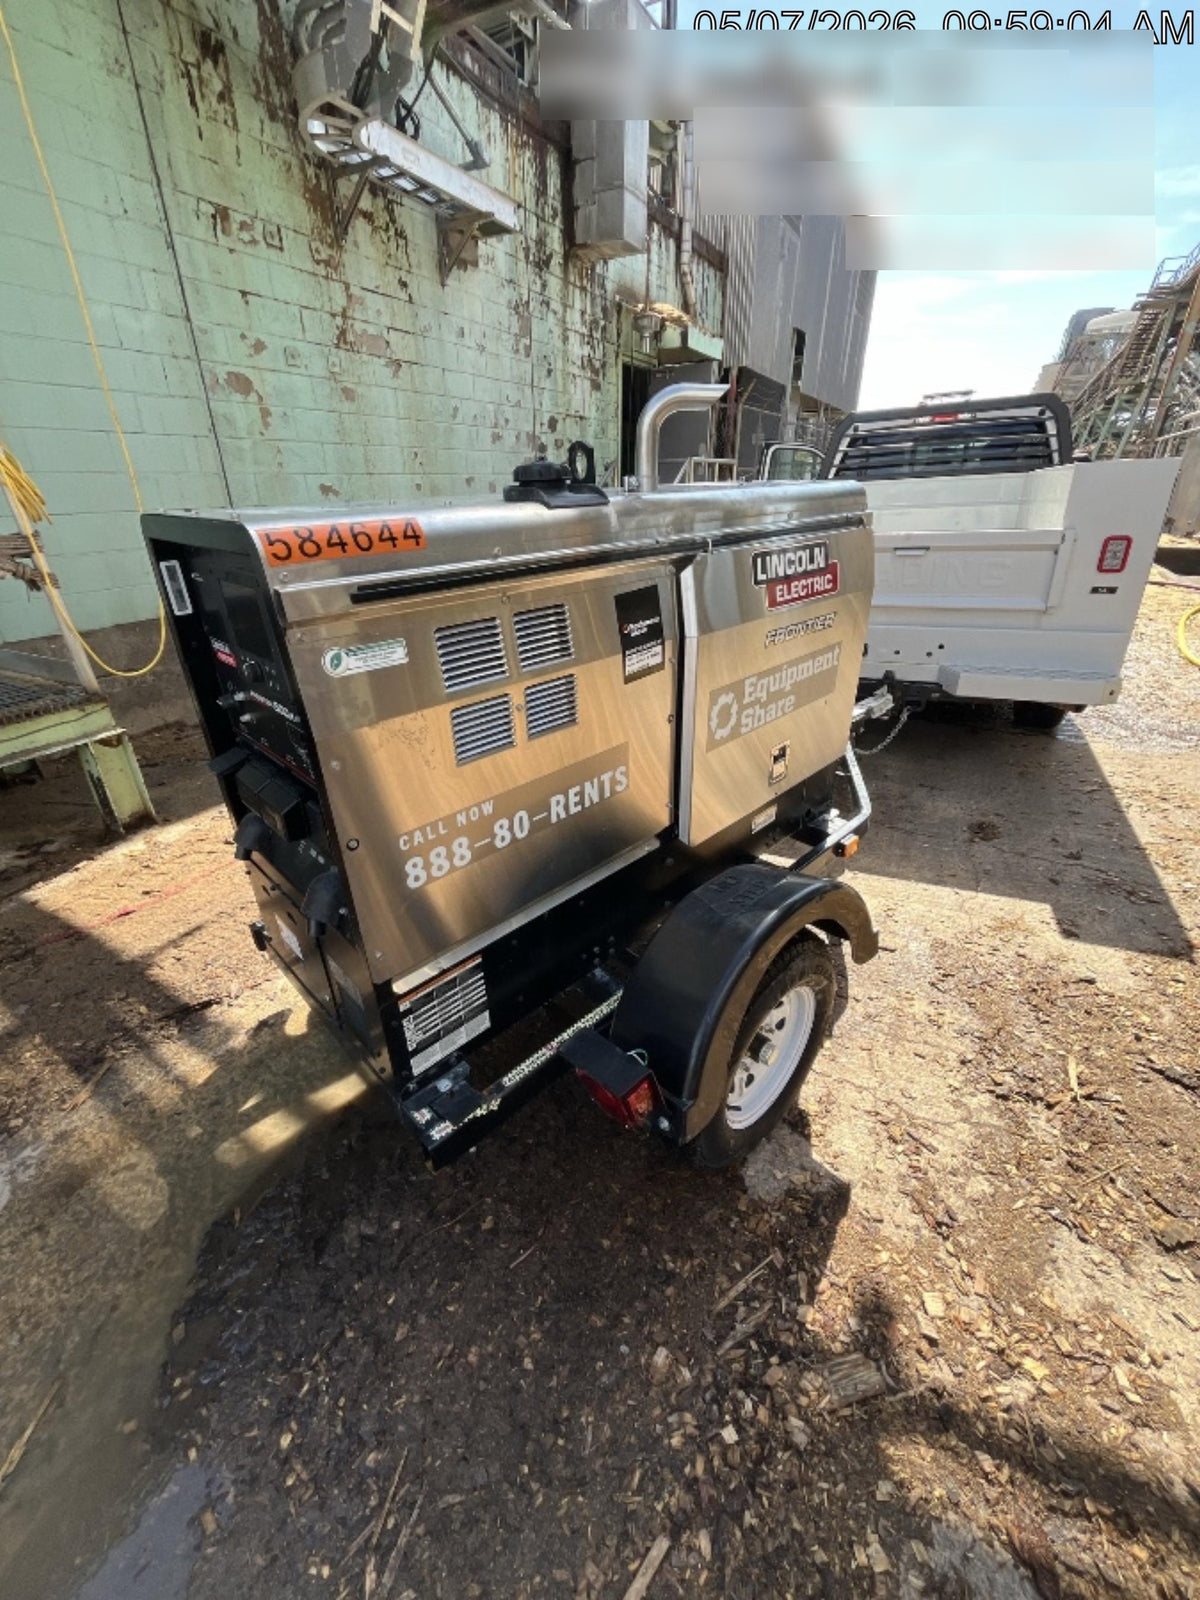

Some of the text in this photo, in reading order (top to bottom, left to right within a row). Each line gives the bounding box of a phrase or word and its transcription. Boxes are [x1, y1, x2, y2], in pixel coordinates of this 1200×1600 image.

[264, 519, 422, 561] 584644
[756, 545, 826, 581] LINCOLN
[775, 573, 833, 602] ELECTRIC
[764, 610, 838, 649] FRONTIER
[742, 644, 840, 705] Equipment
[740, 694, 796, 735] Share
[399, 799, 495, 851] CALL NOW
[404, 765, 629, 891] 888-80-RENTS
